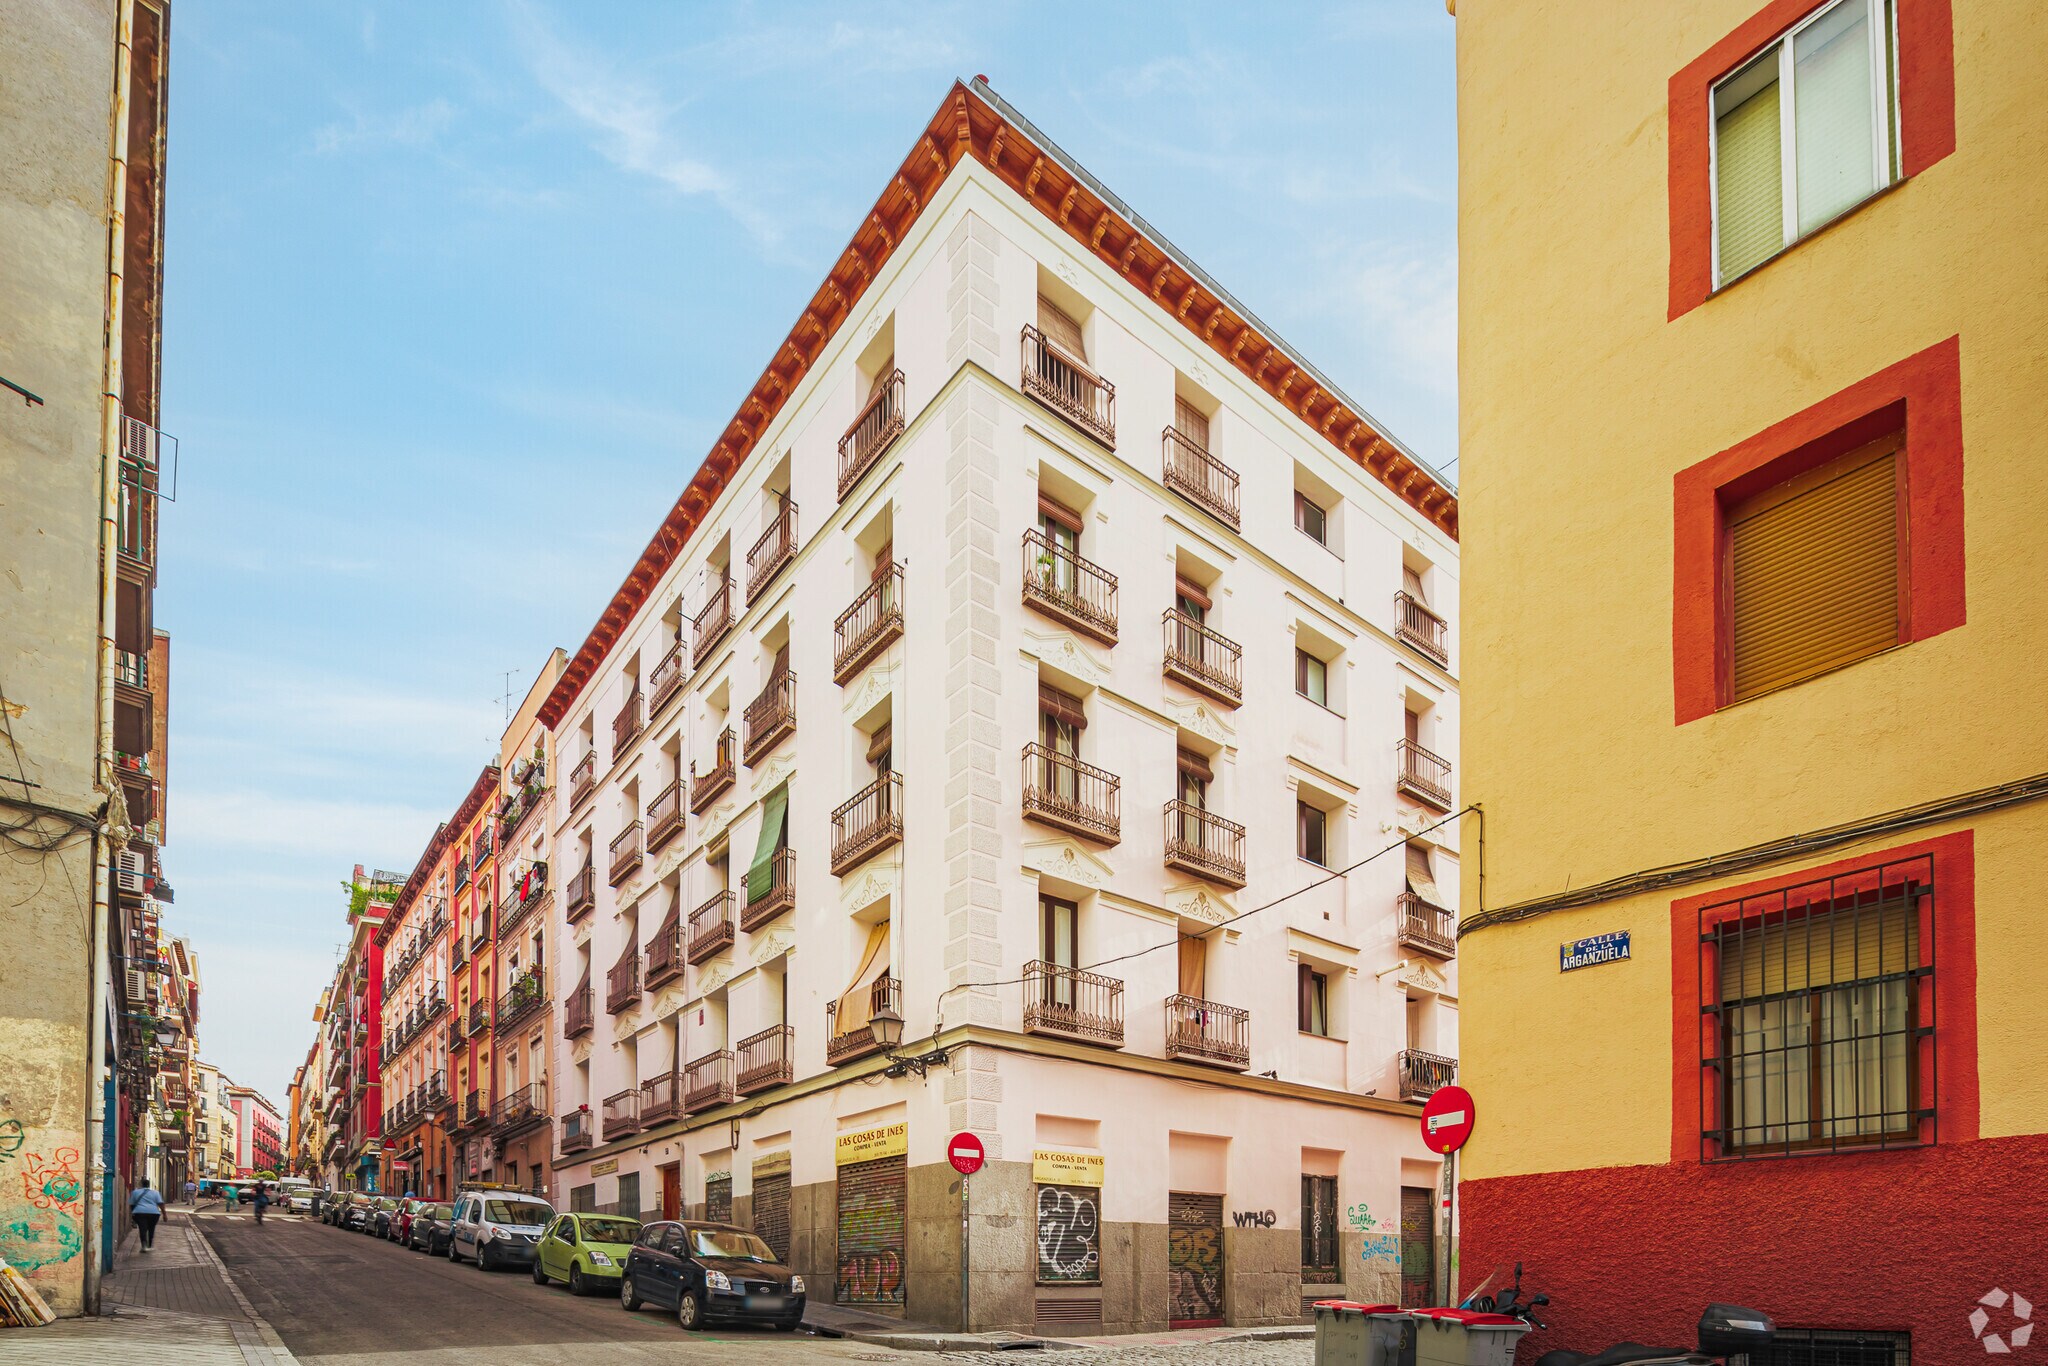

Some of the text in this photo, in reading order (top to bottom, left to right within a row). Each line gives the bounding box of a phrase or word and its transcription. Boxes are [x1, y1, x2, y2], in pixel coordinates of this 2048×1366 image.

[1578, 932, 1624, 948] CALLE
[1585, 942, 1613, 953] DE LA
[1563, 945, 1629, 970] ARGANZUELA
[839, 1125, 904, 1147] LAS COSAS DE INES
[853, 1143, 871, 1151] COMPRA
[1050, 1154, 1075, 1163] COSAS
[1076, 1156, 1085, 1164] DE
[1087, 1157, 1104, 1166] INES
